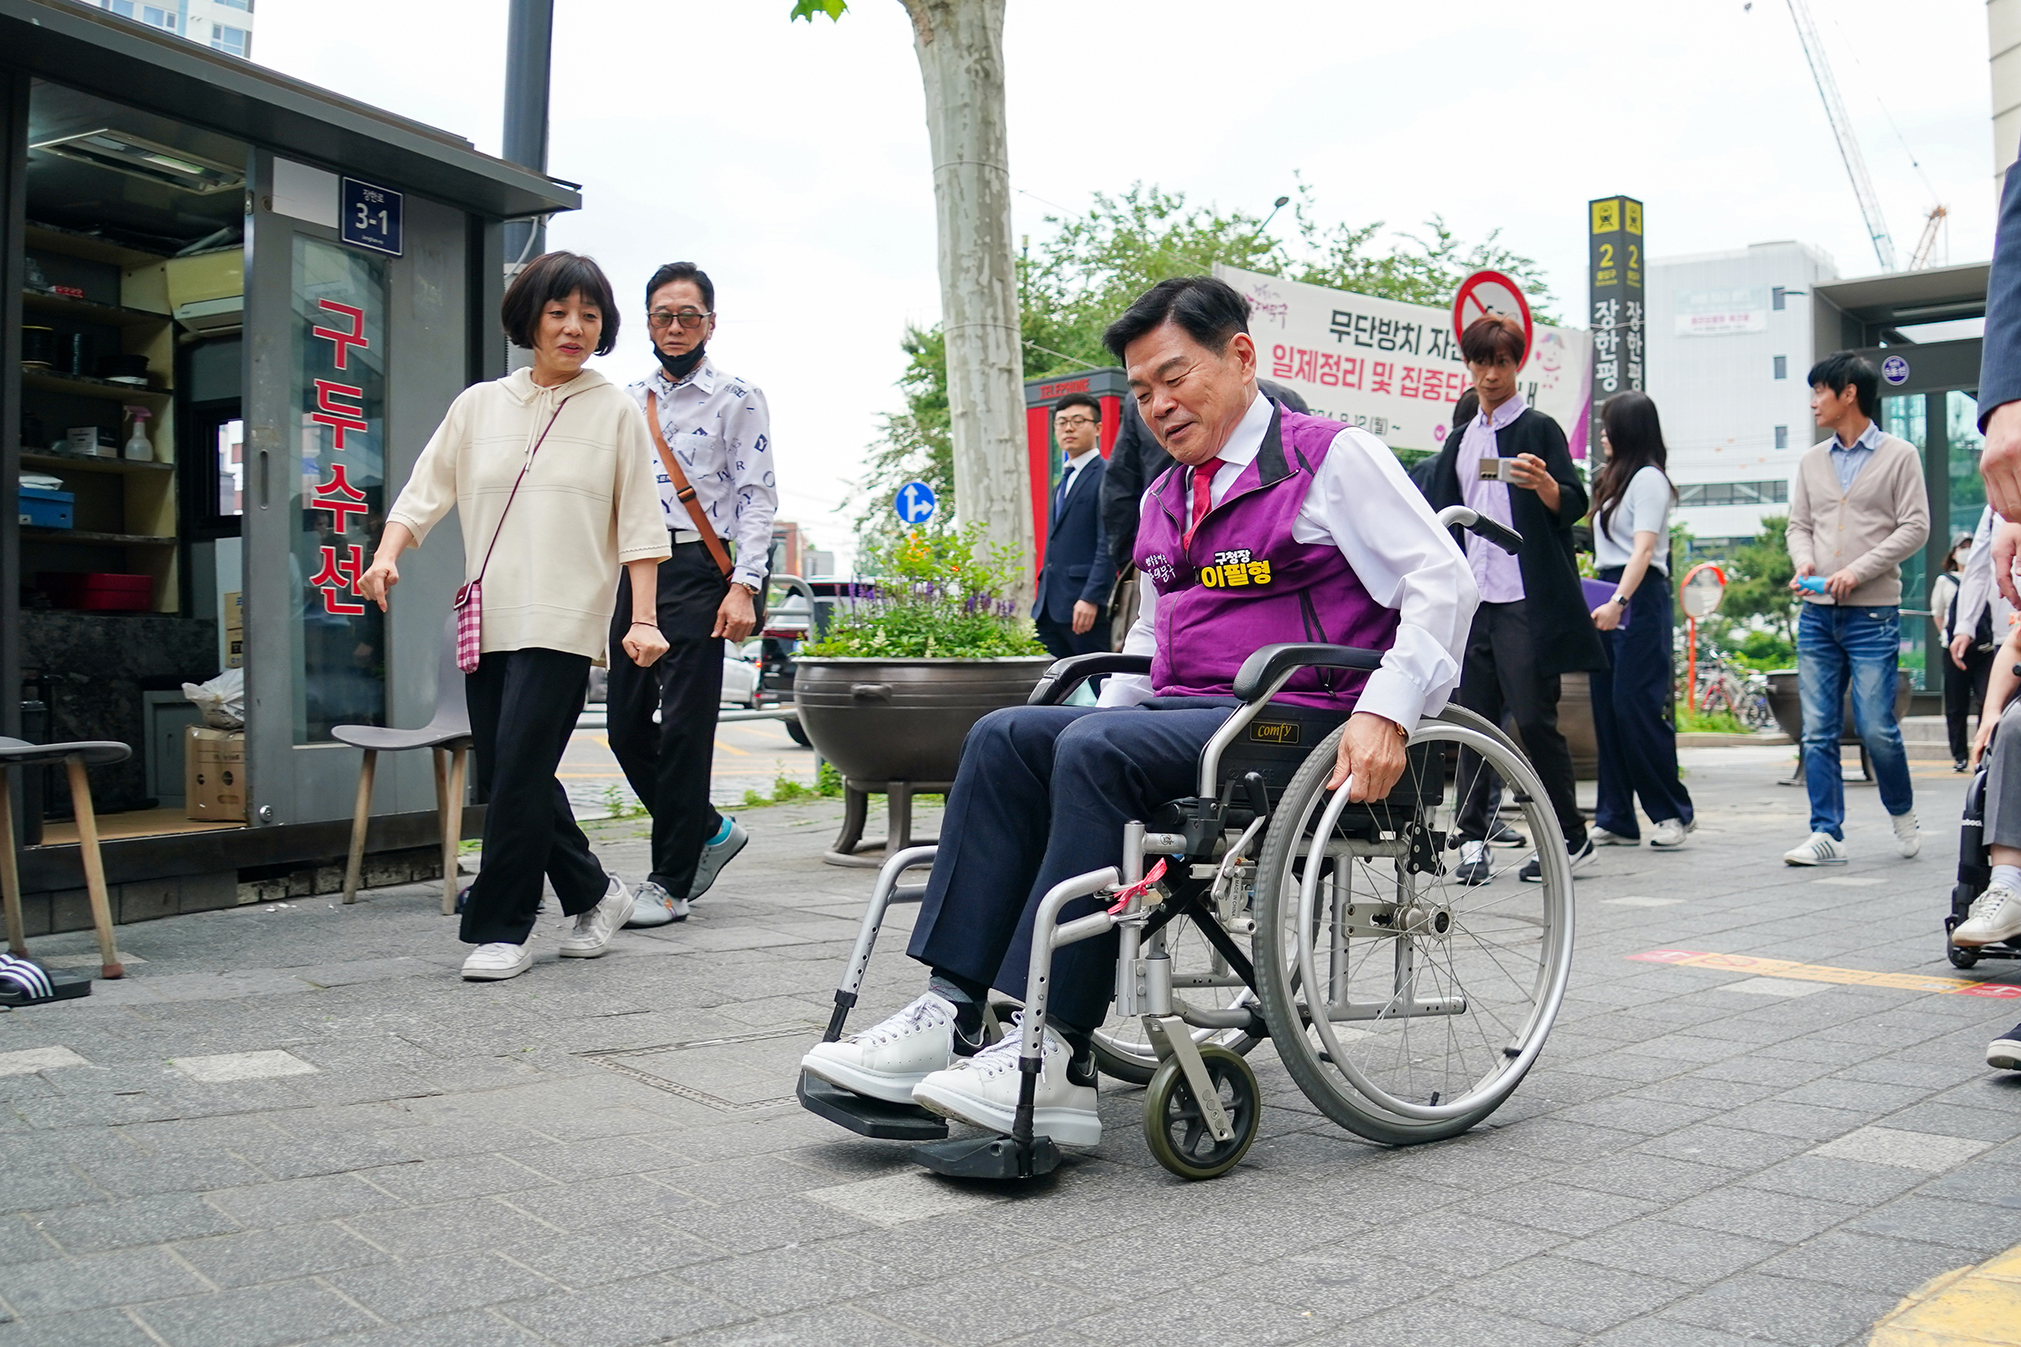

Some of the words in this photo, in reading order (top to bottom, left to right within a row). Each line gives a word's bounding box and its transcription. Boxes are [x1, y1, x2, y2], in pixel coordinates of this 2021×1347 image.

[355, 202, 388, 236] 3-1
[1600, 243, 1614, 267] 2
[1628, 244, 1639, 269] 2
[1329, 309, 1422, 355] 무단방치
[1594, 298, 1620, 392] 장한평
[1626, 301, 1643, 391] 장한평
[1039, 378, 1089, 399] TELEPHONE
[1272, 344, 1364, 390] 일제정리
[1371, 361, 1394, 394] 및
[1400, 366, 1474, 403] 집중단
[309, 297, 369, 615] 구두수선
[1214, 549, 1251, 565] 구청장
[1201, 560, 1272, 588] 이필형
[1258, 723, 1292, 743] comfy
